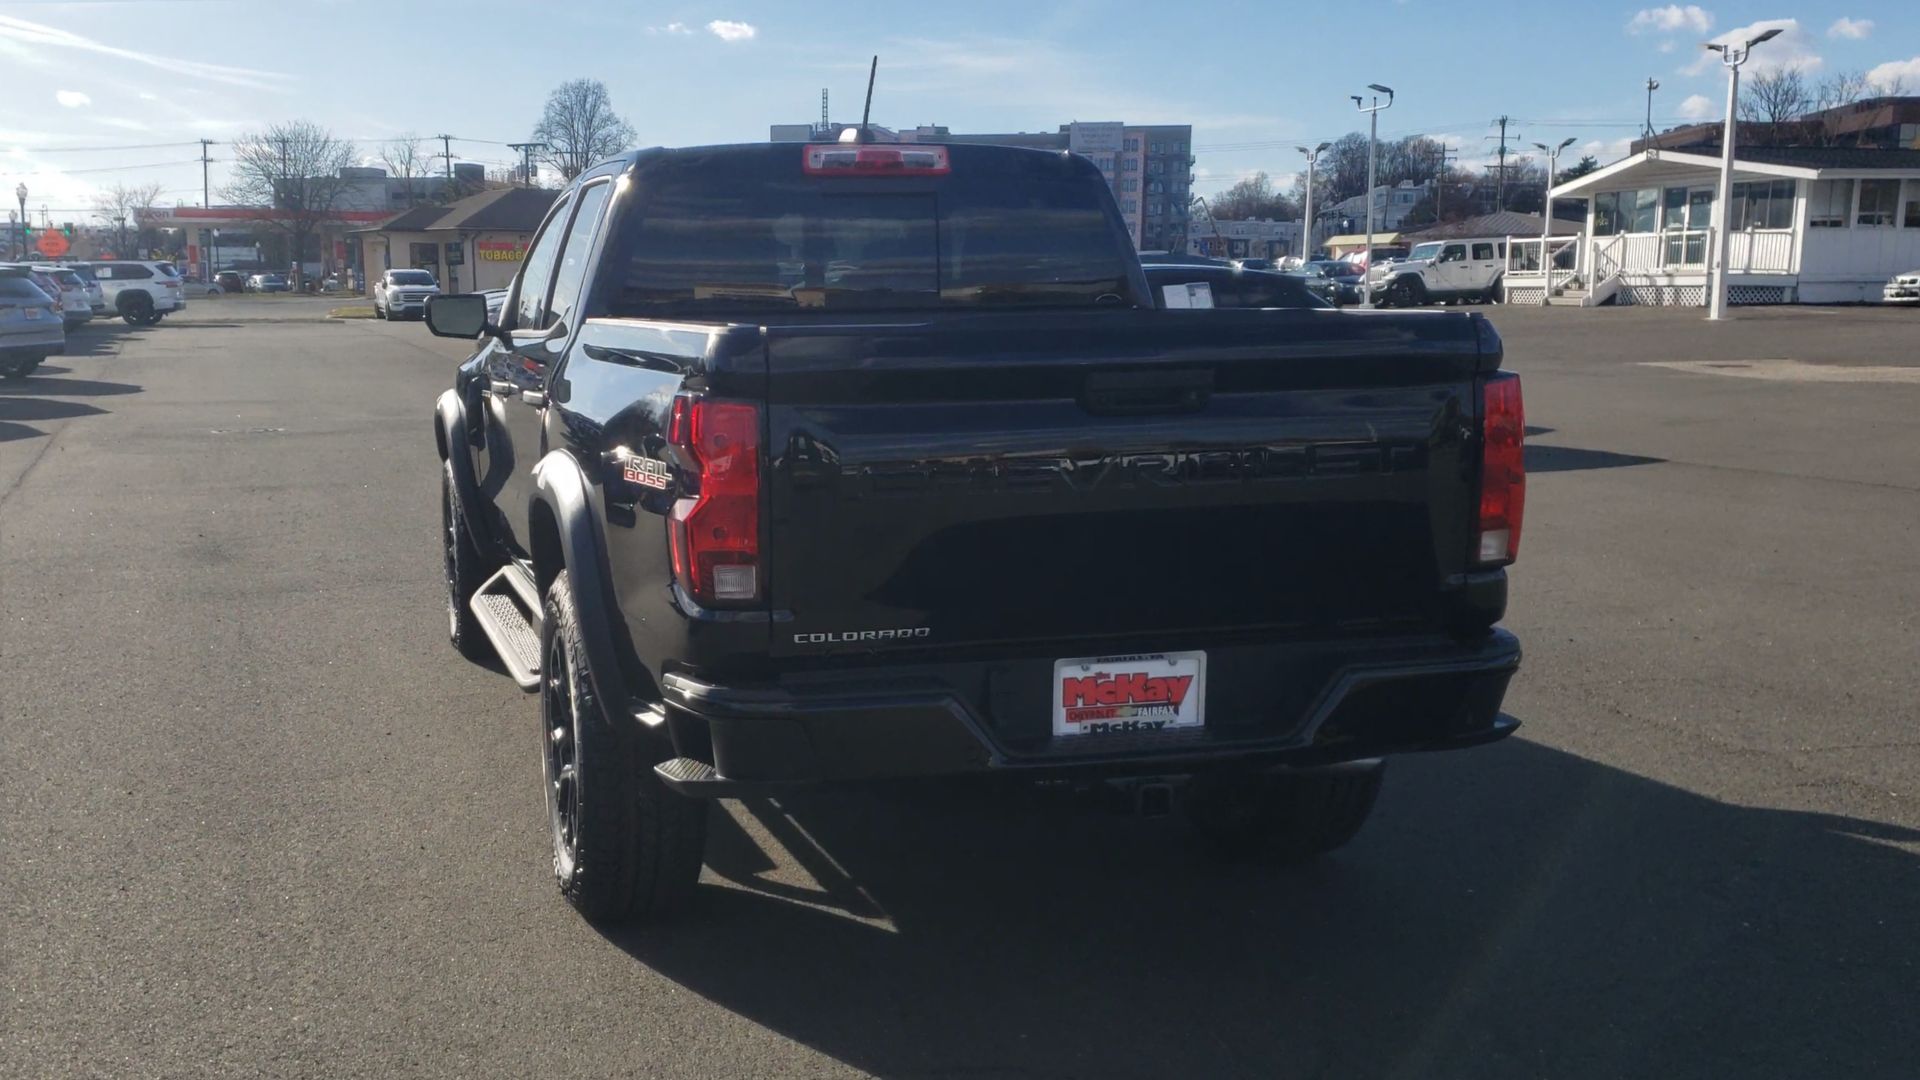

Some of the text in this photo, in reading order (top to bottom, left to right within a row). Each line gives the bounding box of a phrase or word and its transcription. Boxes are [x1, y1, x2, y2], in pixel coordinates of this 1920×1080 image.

[480, 250, 527, 260] TOBACC
[624, 468, 666, 490] BOSS
[794, 627, 930, 643] COLORADO
[1063, 672, 1194, 707] McKay
[1137, 705, 1175, 717] FAIRFAX
[1091, 720, 1165, 734] McKay
